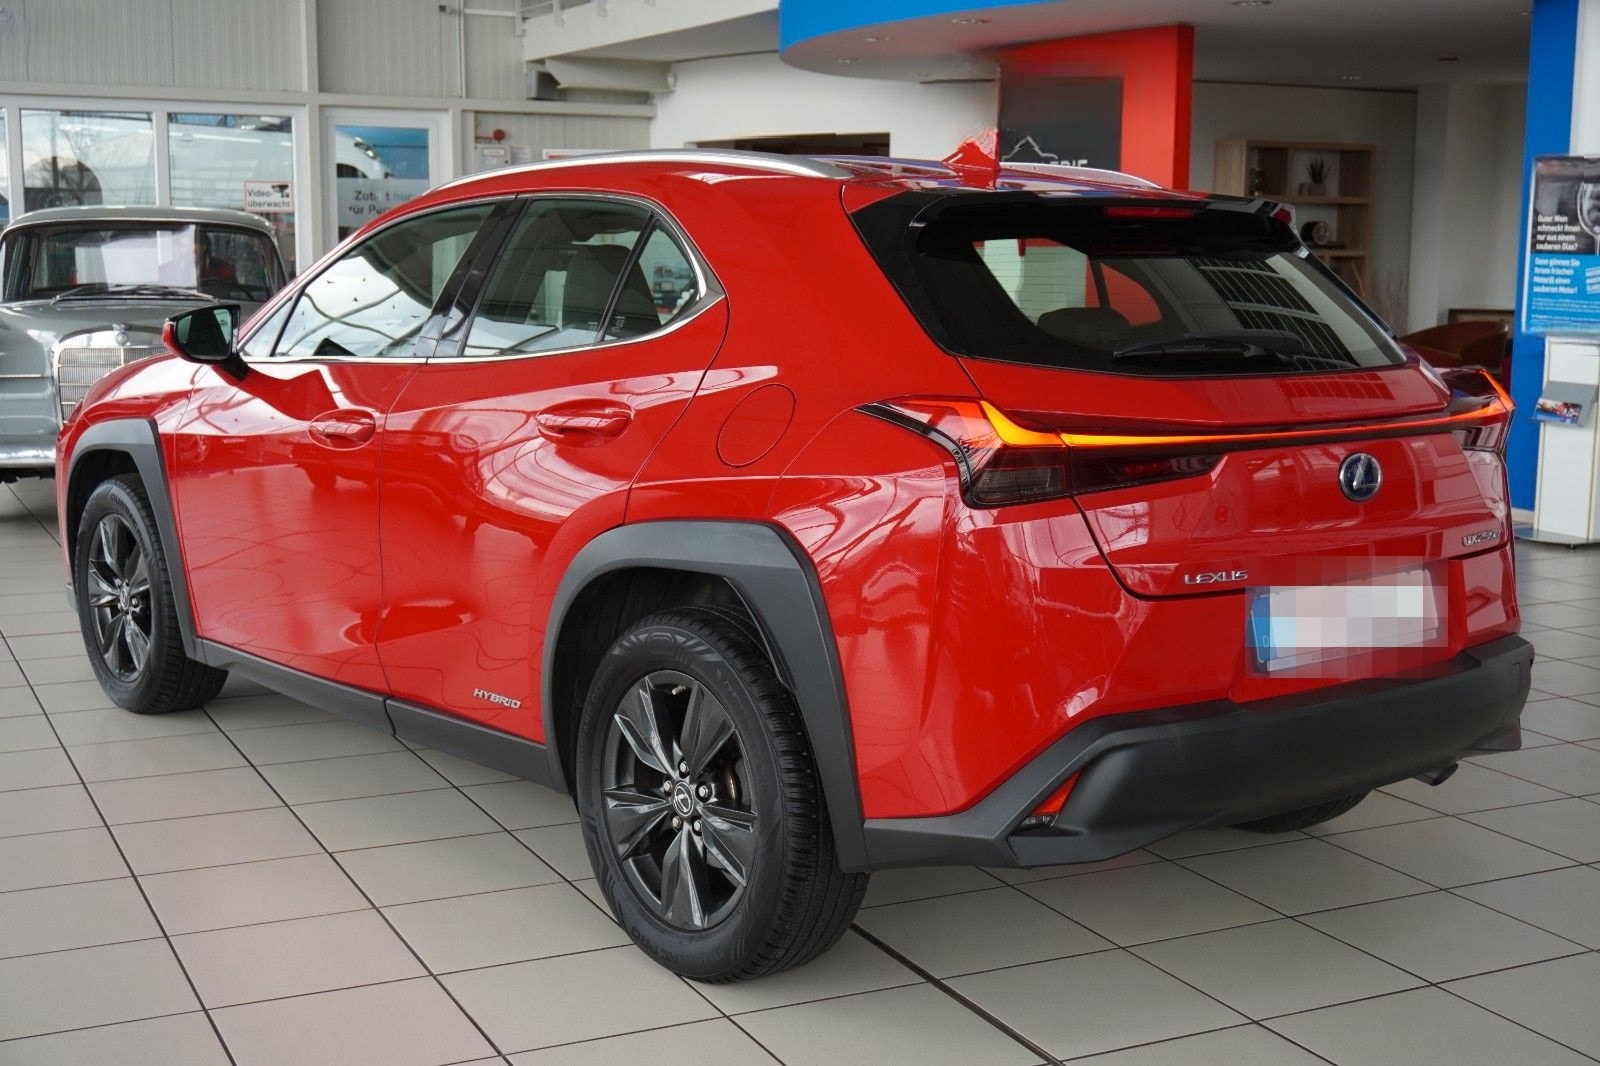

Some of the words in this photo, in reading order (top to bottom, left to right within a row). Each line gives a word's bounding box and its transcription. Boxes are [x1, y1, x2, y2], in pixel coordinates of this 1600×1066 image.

[247, 199, 290, 208] überwacht
[1537, 214, 1553, 223] Guter
[1553, 214, 1568, 223] Wein
[1564, 224, 1580, 232] Ihnen
[1561, 242, 1578, 251] Glas?
[1184, 569, 1249, 585] LEXUS
[473, 688, 521, 709] HYBRID
